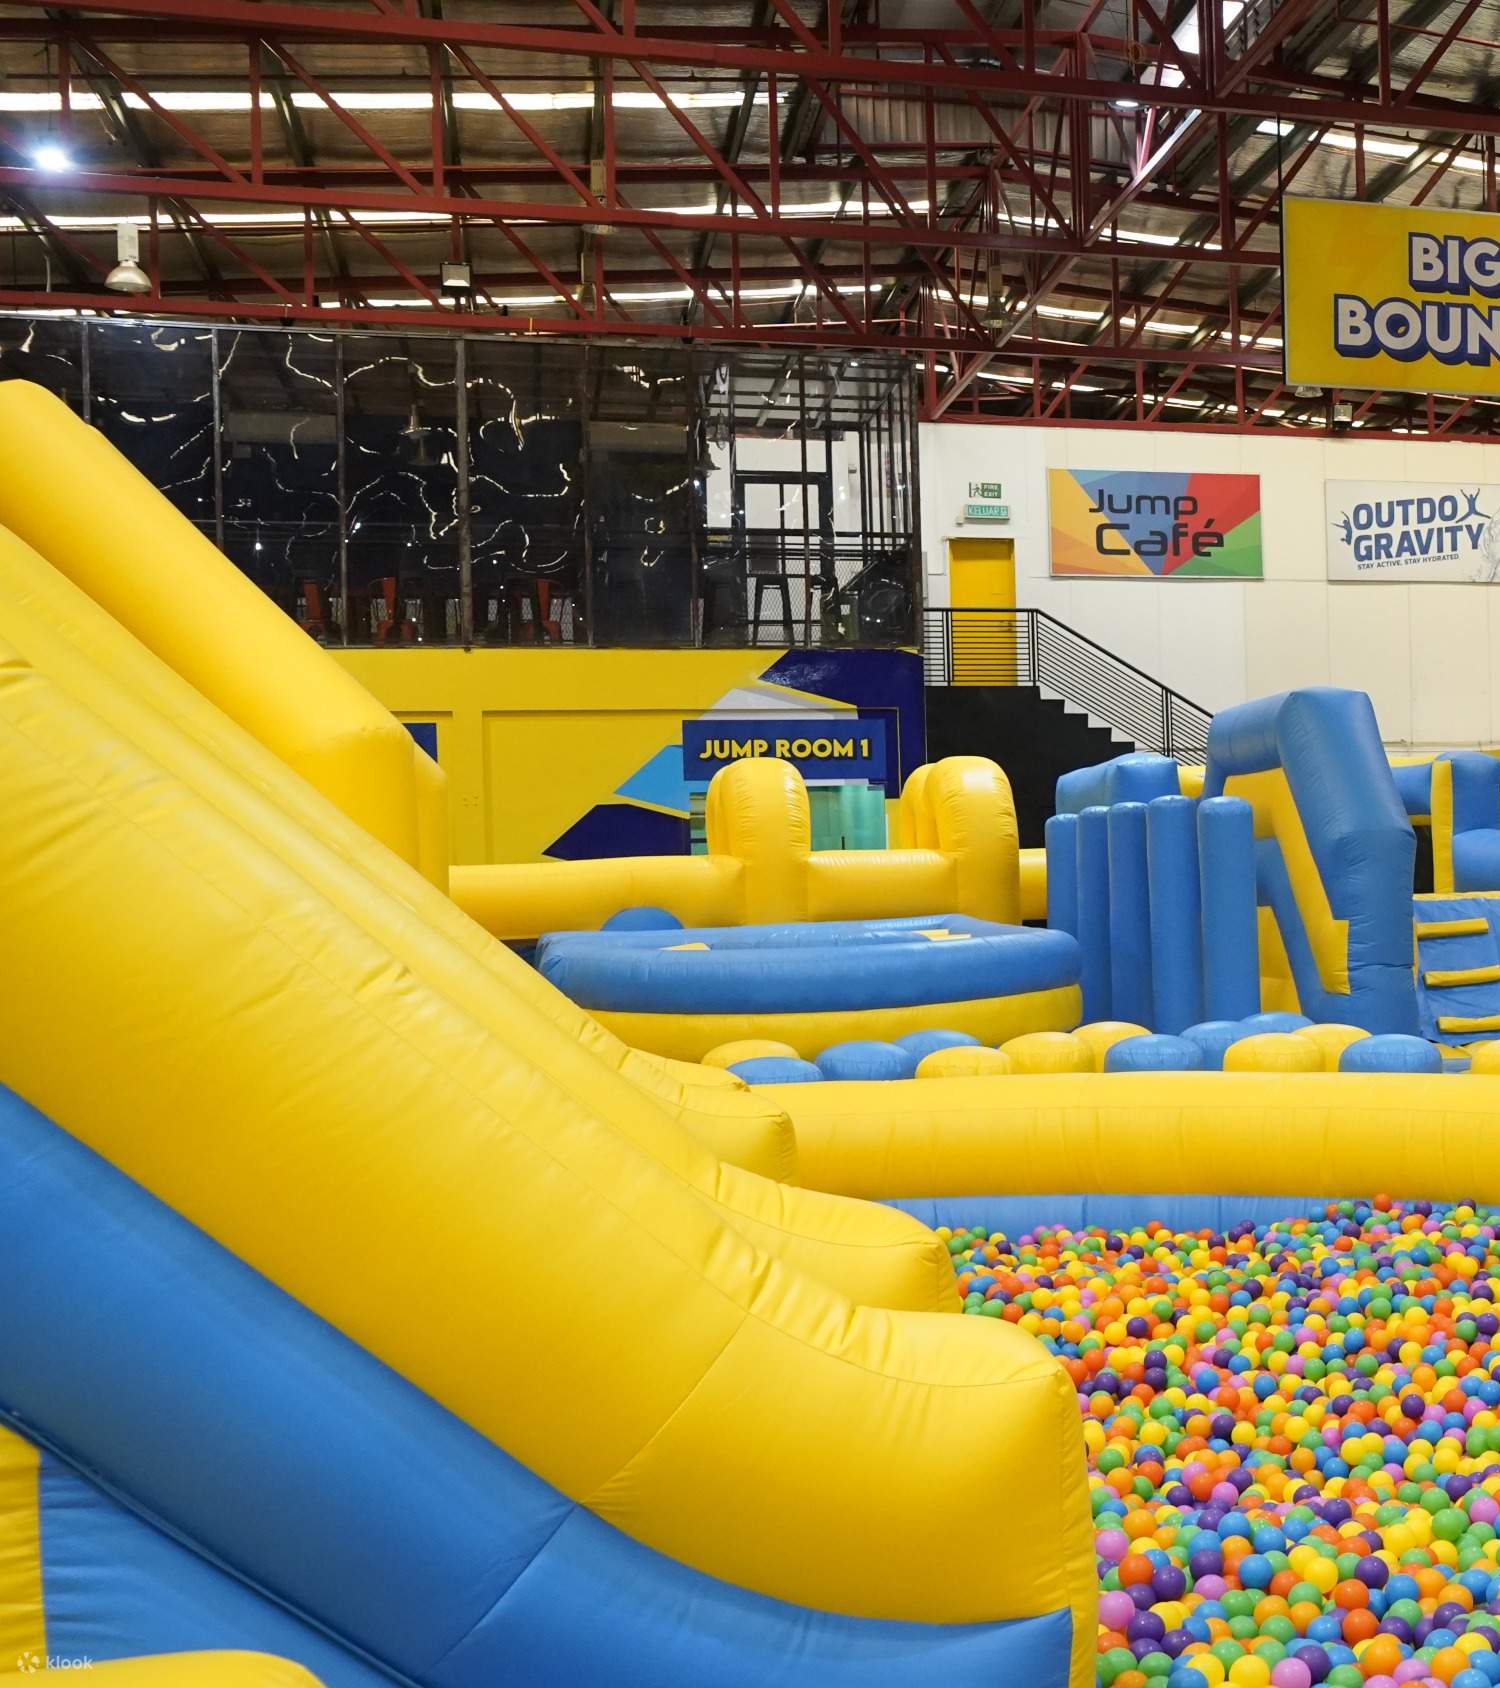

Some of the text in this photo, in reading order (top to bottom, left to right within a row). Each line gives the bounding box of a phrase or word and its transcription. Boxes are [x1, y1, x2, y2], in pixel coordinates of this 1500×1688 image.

[1089, 489, 1198, 521] Jump
[1353, 495, 1458, 531] OUTDO
[1096, 519, 1224, 557] Café
[1354, 523, 1485, 562] GRAVITY
[1357, 562, 1374, 571] STAY
[1405, 558, 1420, 566] STAY
[1422, 554, 1459, 563] HYDRATED
[699, 738, 869, 759] JUMP ROOM 1
